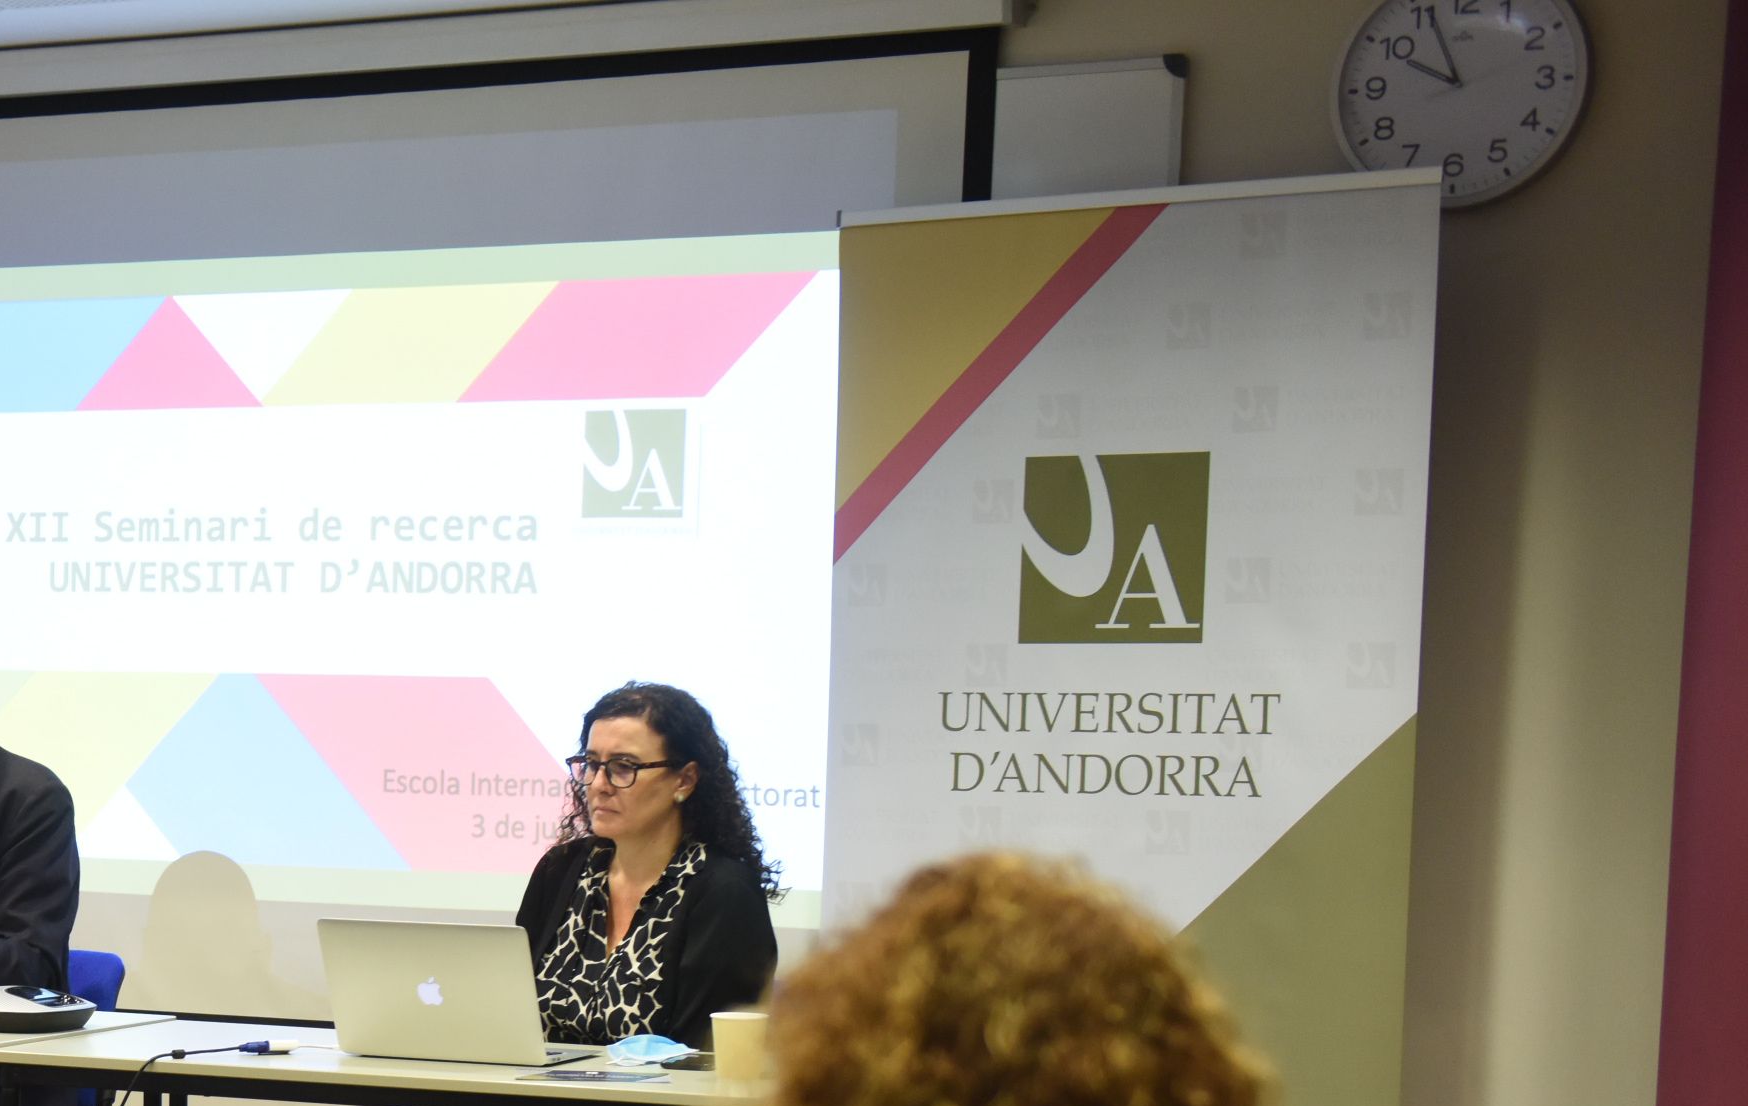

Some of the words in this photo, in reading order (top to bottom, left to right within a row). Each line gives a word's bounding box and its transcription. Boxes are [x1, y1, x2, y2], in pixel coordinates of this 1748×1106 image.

[1410, 5, 1435, 30] 11
[1379, 35, 1415, 61] 10
[1523, 26, 1546, 51] 2
[1365, 76, 1387, 101] 9
[1534, 65, 1556, 90] 3
[1373, 116, 1395, 141] 8
[1519, 107, 1541, 132] 4
[1401, 143, 1421, 168] 7
[1487, 138, 1508, 164] 5
[1442, 153, 1465, 178] 6
[5, 511, 70, 543] XII
[94, 507, 272, 543] Seminari
[298, 507, 342, 542] de
[369, 514, 538, 542] recerca
[49, 561, 295, 593] UNIVERSITAT
[320, 558, 538, 594] D'ANDORRA
[938, 691, 1282, 735] UNIVERSITAT
[382, 768, 460, 796] Escola
[949, 751, 1262, 798] D'ANDORRA
[471, 814, 486, 839] 3
[495, 813, 525, 839] de
